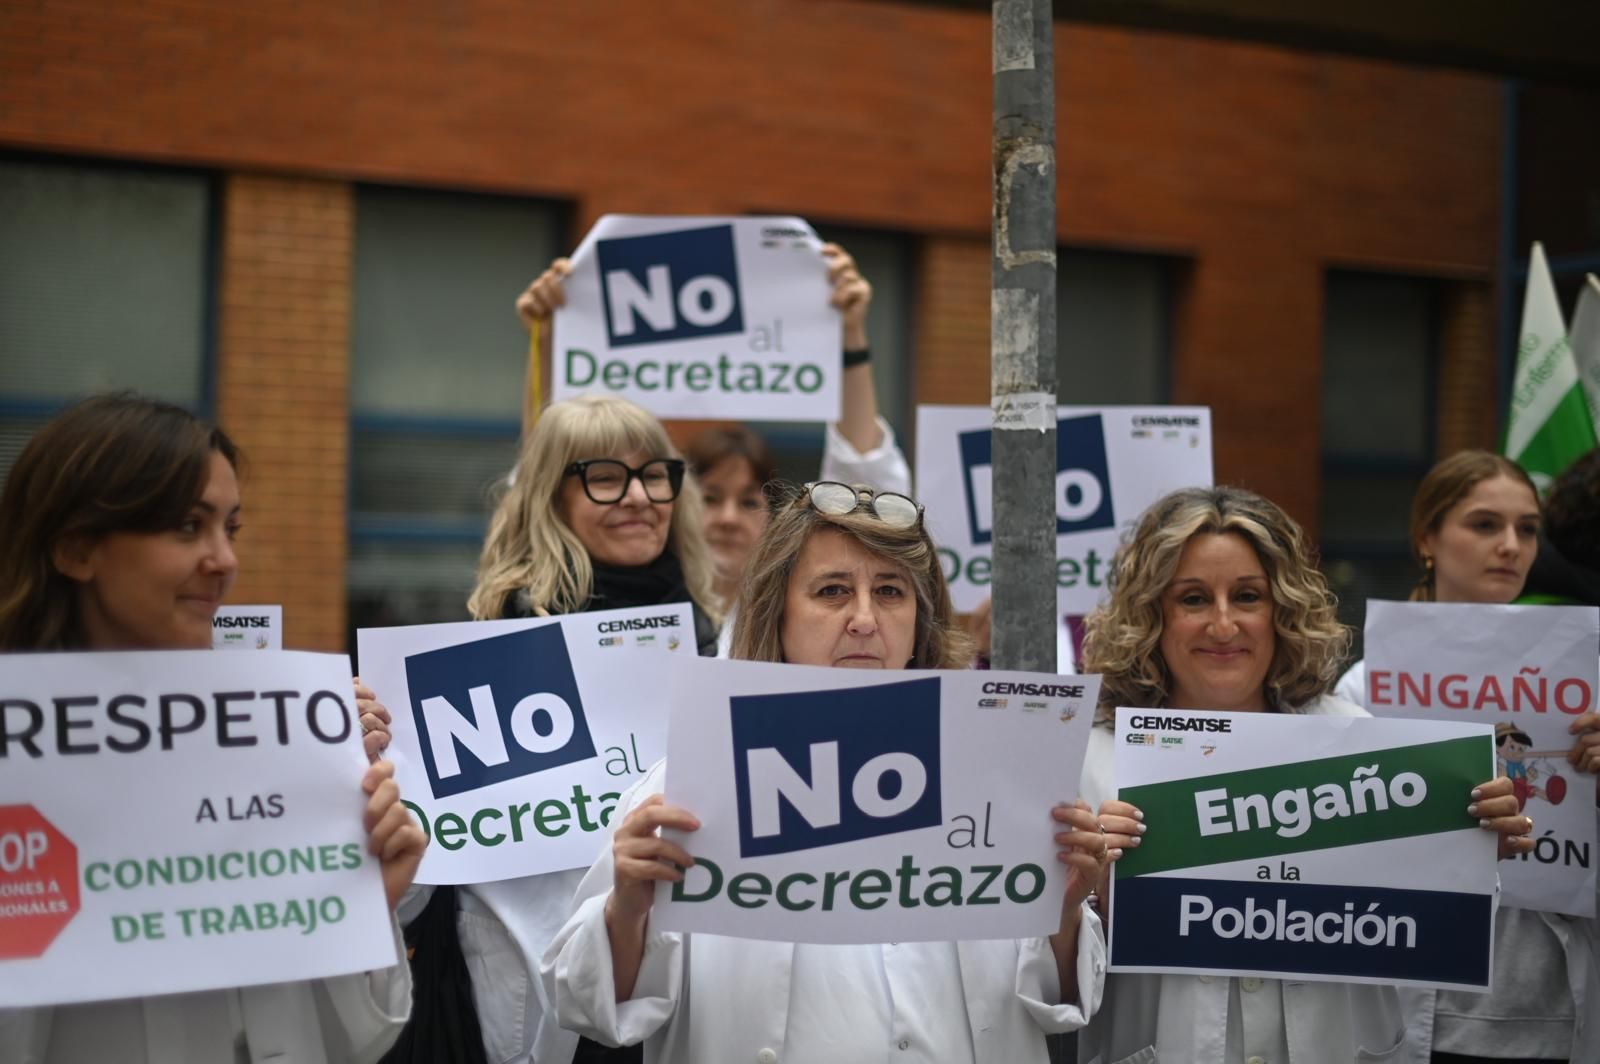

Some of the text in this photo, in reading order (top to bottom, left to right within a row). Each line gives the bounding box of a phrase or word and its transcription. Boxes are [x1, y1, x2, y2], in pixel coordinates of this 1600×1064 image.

[606, 264, 783, 352] No al
[565, 349, 824, 393] Decretazo
[936, 548, 1116, 588] Deet
[598, 614, 681, 634] CEMSATSE
[982, 681, 1085, 699] CEMSATSE
[1370, 667, 1591, 714] ENGAÑO
[0, 690, 352, 759] RESPETO
[421, 684, 646, 779] No al
[1130, 716, 1232, 733] CEMSATSE
[196, 795, 285, 824] A LAS
[746, 740, 995, 848] No al
[1194, 764, 1427, 838] Engaño
[84, 843, 363, 892] CONDICIONES
[1257, 861, 1301, 881] a la
[1504, 829, 1590, 868] ÓN
[0, 880, 45, 896] ONES
[671, 855, 1046, 912] Decretazo
[111, 895, 346, 943] DE TRABAJO
[1179, 894, 1417, 948] Población
